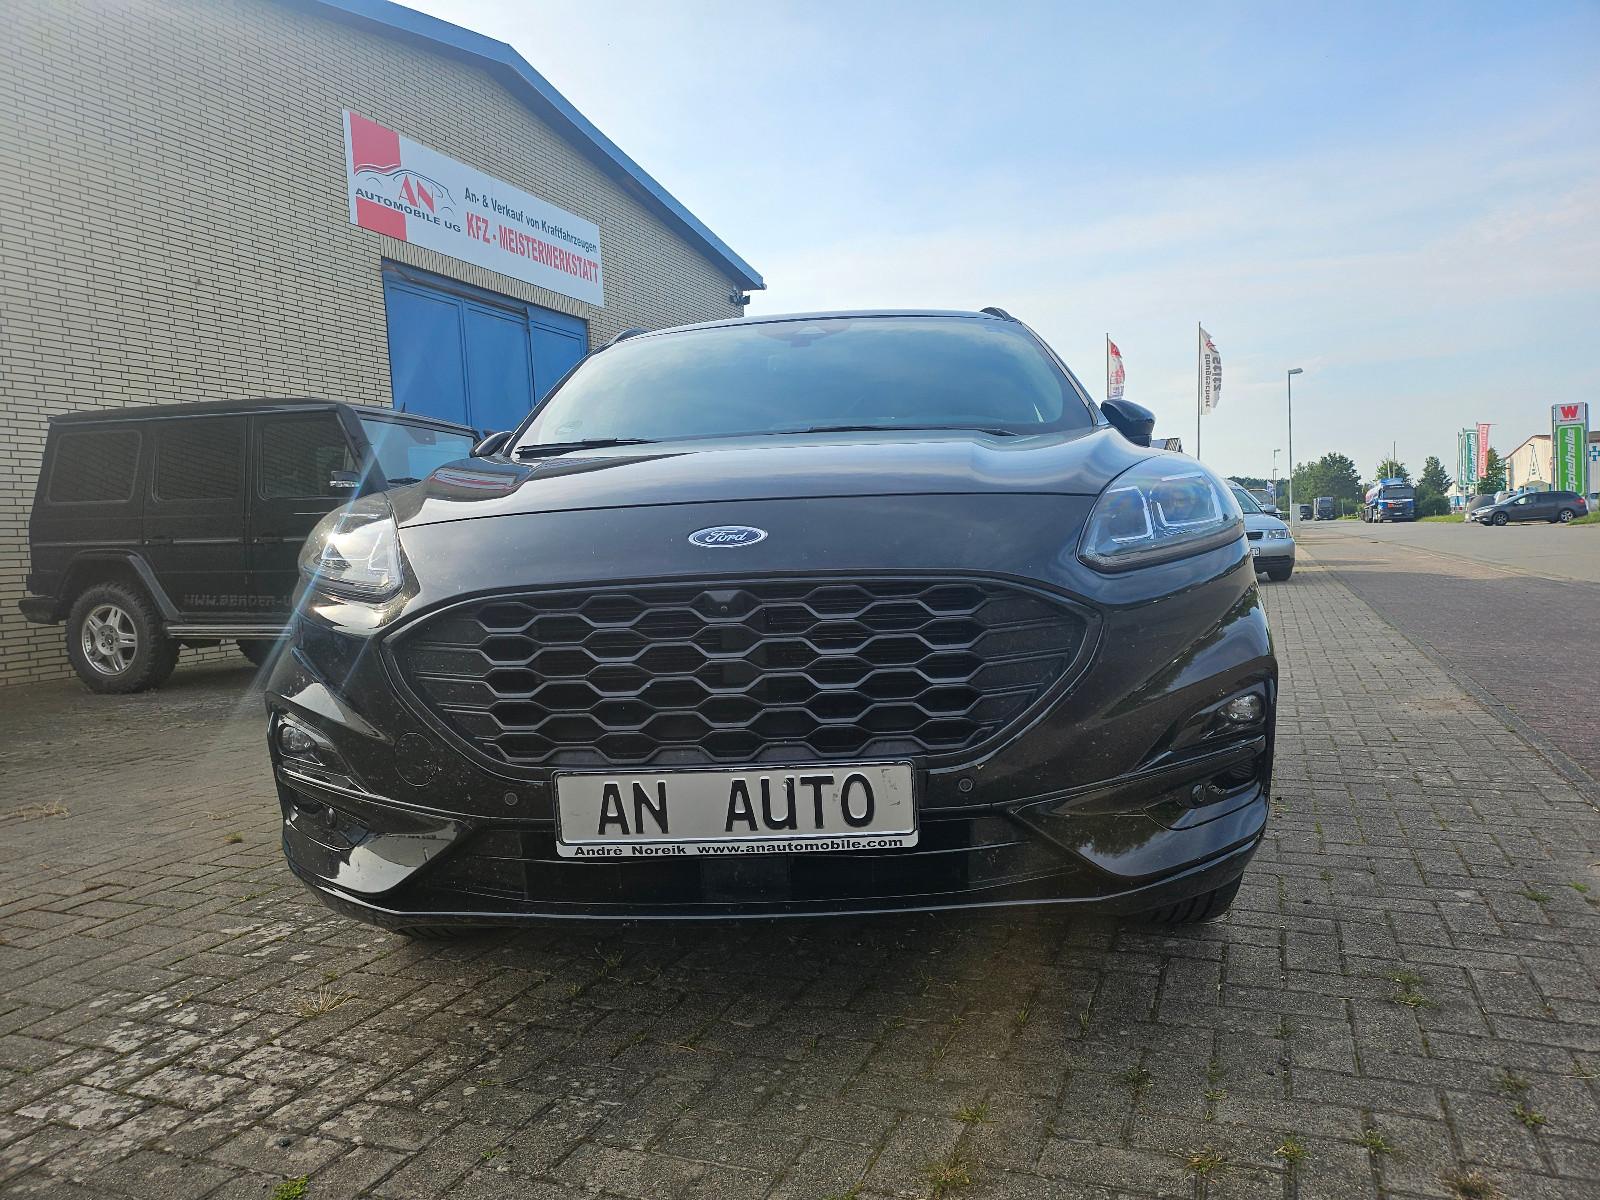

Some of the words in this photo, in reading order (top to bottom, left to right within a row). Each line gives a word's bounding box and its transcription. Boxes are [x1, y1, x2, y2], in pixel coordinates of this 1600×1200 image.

[355, 187, 441, 226] AUTOMOBILE
[444, 220, 461, 234] UG
[399, 174, 435, 214] AN
[466, 212, 491, 244] KFZ
[498, 224, 599, 284] MEISTERWERKSTATT
[482, 195, 489, 208] &
[491, 198, 524, 224] Verkauf
[525, 215, 540, 230] von
[541, 220, 598, 254] Kraftfahrzeugen
[1561, 405, 1579, 418] W
[1565, 428, 1576, 492] Spielhalle
[704, 529, 748, 543] Ford
[598, 781, 670, 835] AN
[725, 772, 875, 832] AUTO
[631, 845, 687, 856] Noreik
[696, 838, 903, 854] www.anautomobile.com
